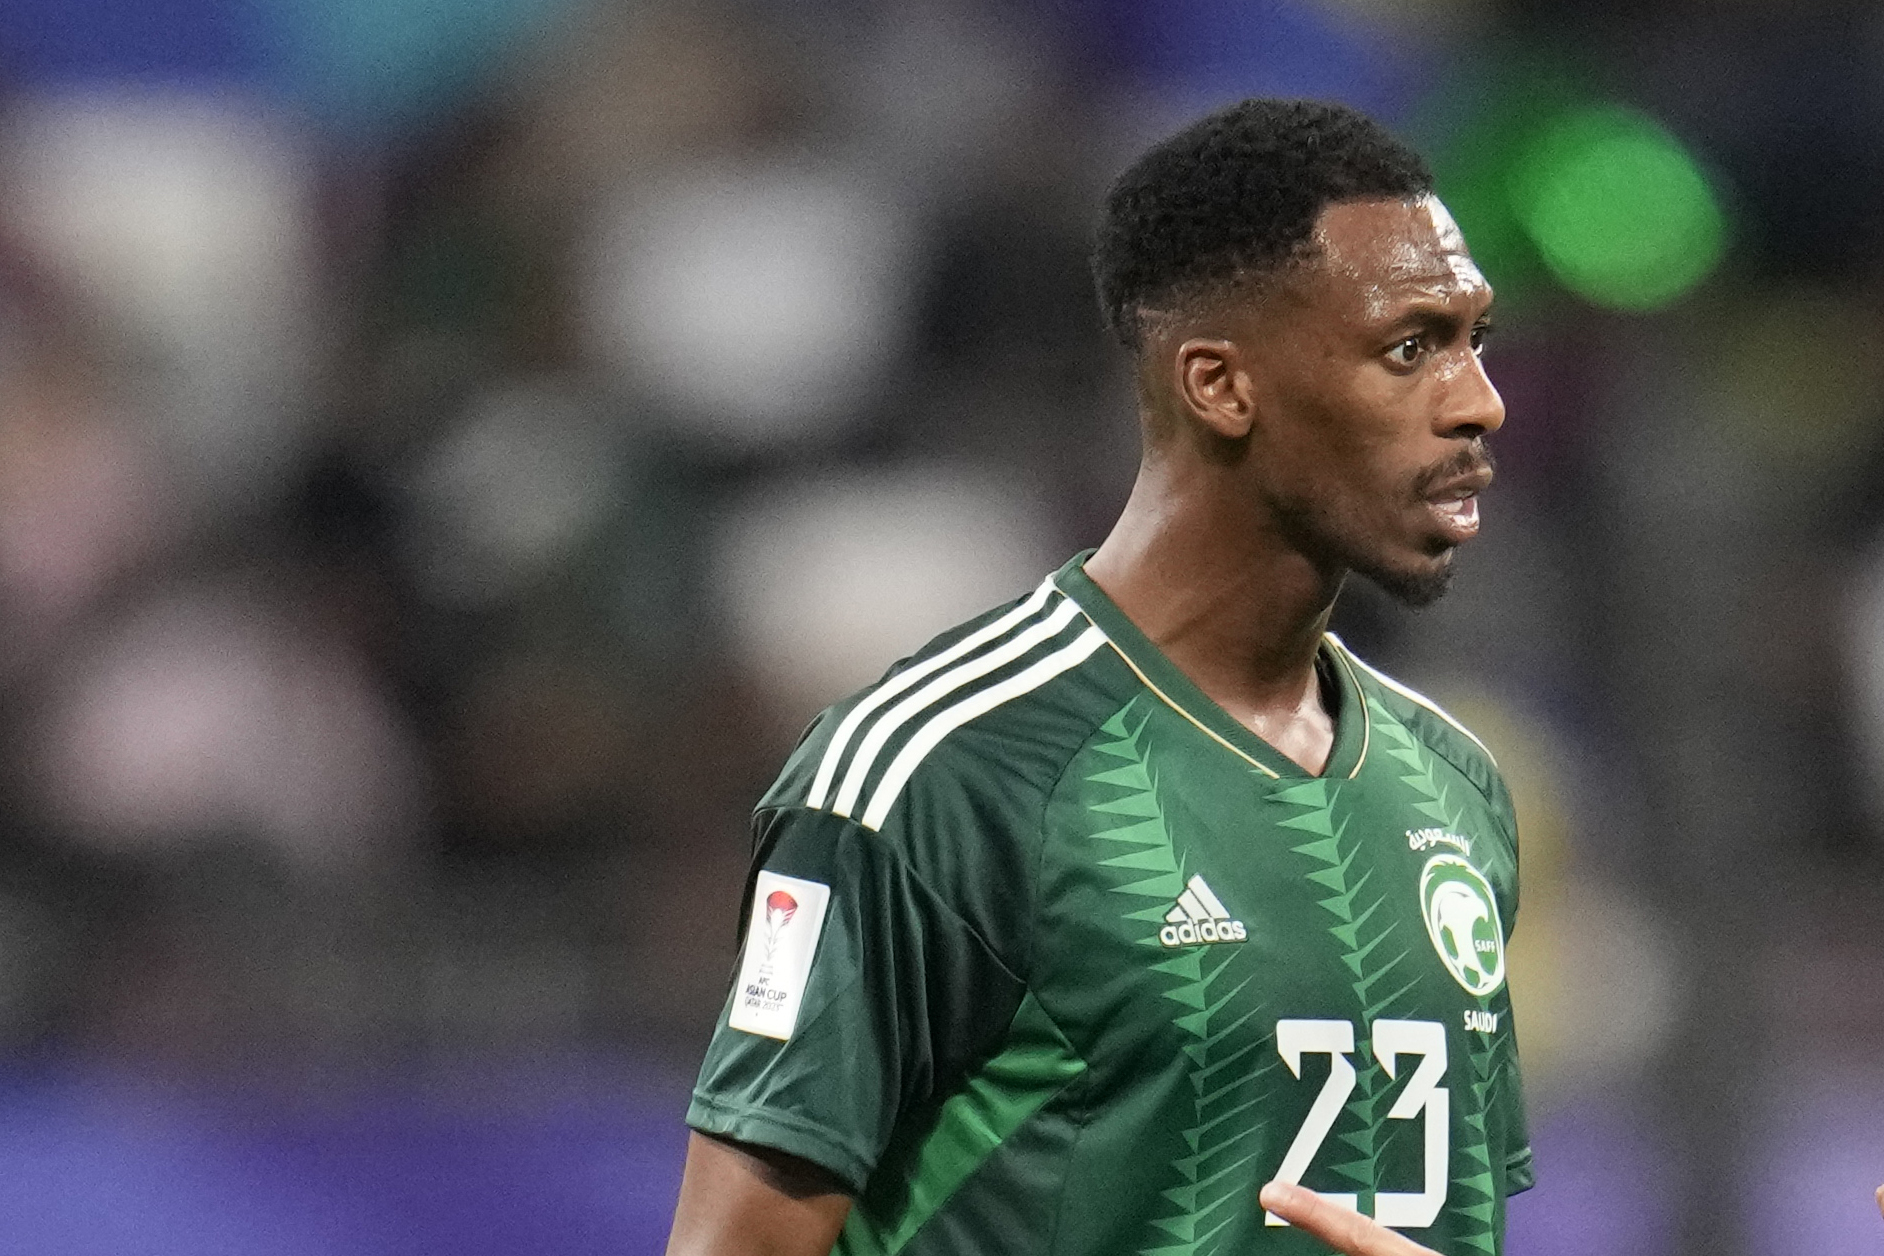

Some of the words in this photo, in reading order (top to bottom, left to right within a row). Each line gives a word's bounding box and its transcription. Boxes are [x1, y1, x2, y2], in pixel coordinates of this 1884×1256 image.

[1160, 917, 1247, 946] adidas
[1475, 940, 1496, 954] SAFF
[745, 984, 766, 998] ASIAN
[767, 989, 787, 1002] CUP
[1464, 1010, 1498, 1033] SAUDI
[1264, 1018, 1450, 1228] 23
